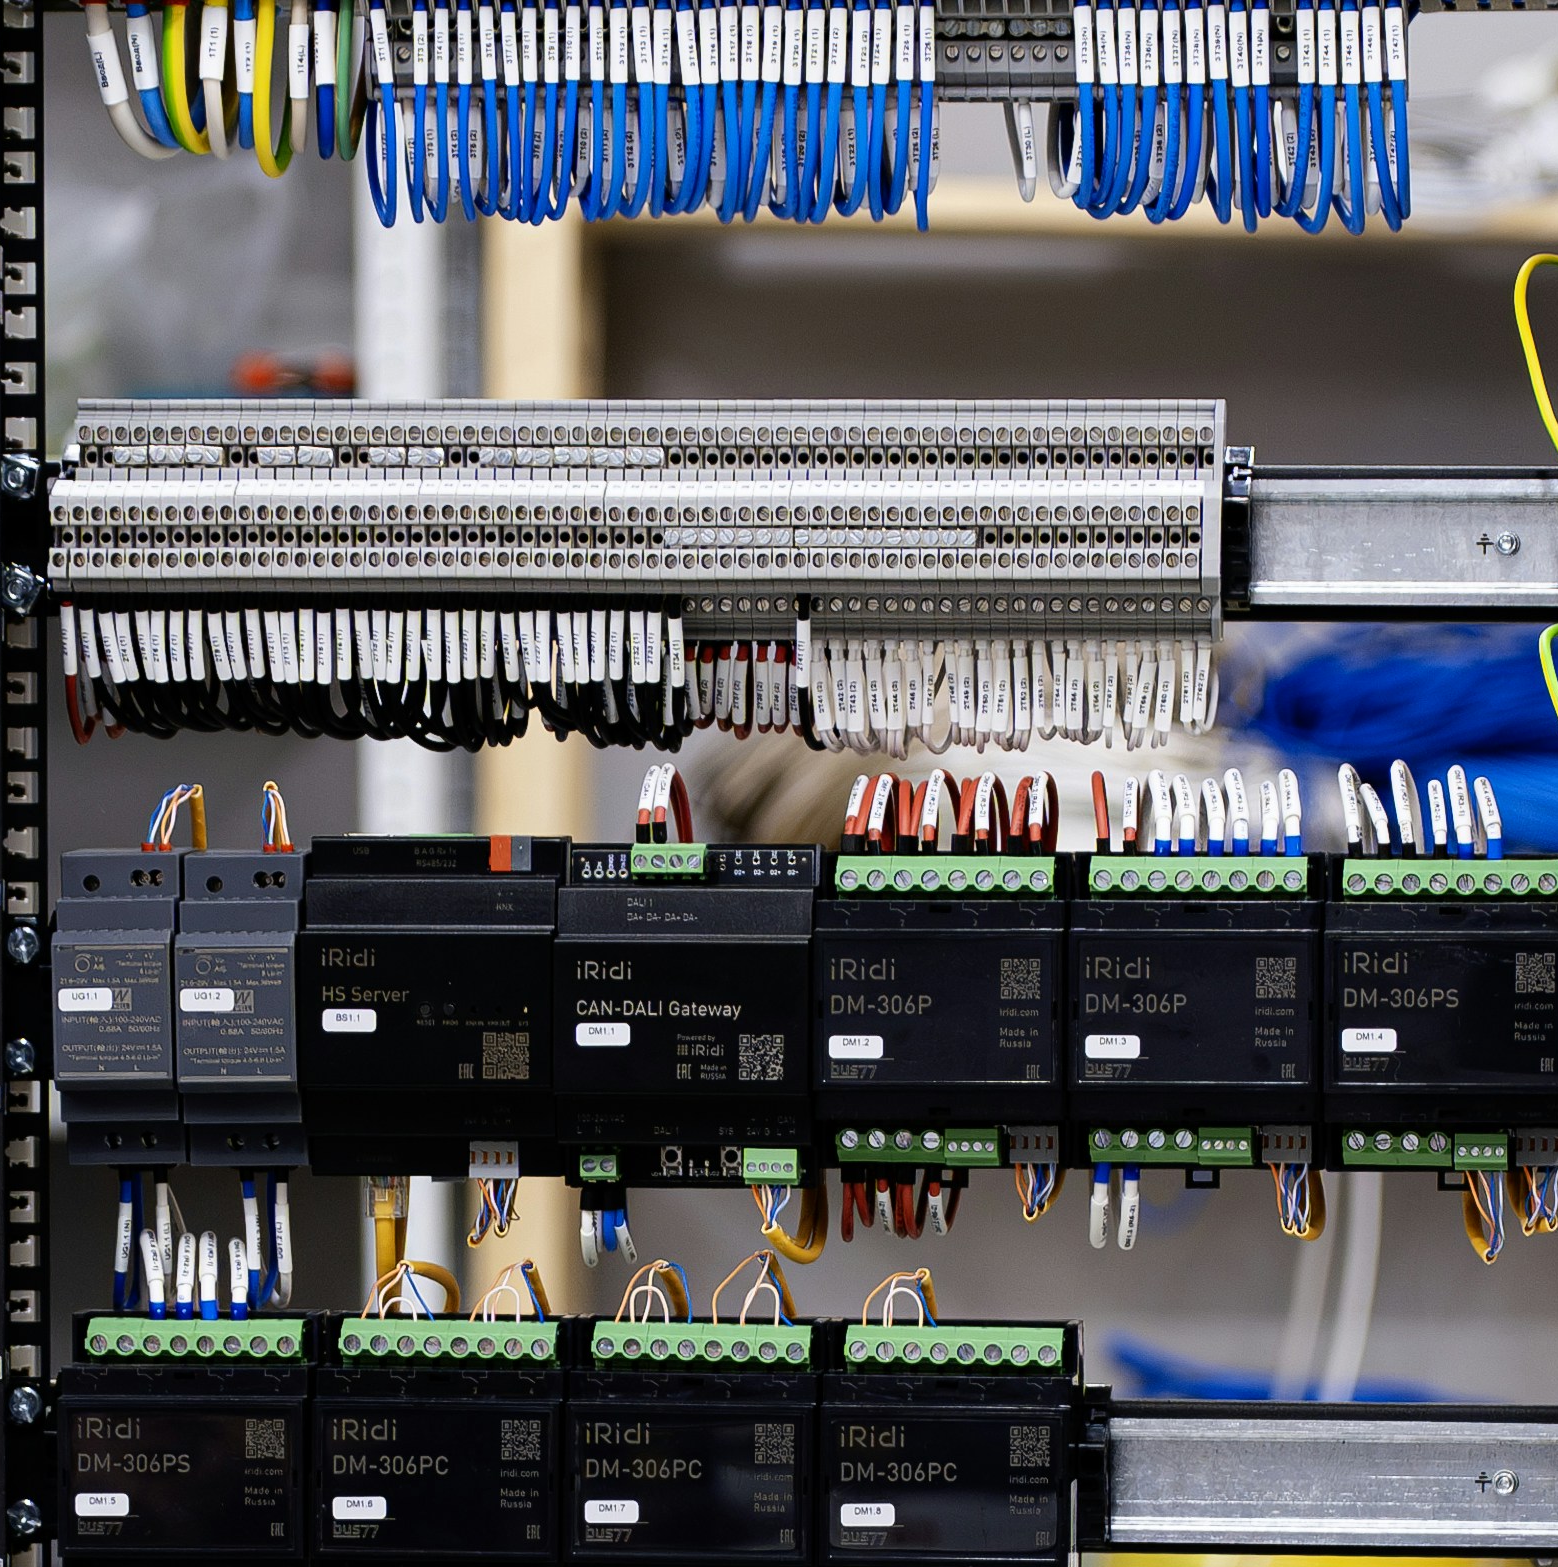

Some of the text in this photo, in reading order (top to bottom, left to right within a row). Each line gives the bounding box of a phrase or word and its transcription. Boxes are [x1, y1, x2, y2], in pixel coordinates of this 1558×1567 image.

[322, 949, 375, 966] iRidi
[1345, 952, 1407, 974] iRidi
[578, 961, 631, 979] iRidi
[831, 958, 894, 980] iRidi
[1086, 957, 1150, 979] iRidi
[323, 986, 409, 1002] HS Server
[1086, 994, 1186, 1013] DM-306P
[1344, 988, 1458, 1007] DM-306PS
[577, 1000, 741, 1020] CAN-DALI Gateway
[831, 995, 931, 1014] DM-306P
[78, 1418, 139, 1439] iRidi
[333, 1419, 396, 1440] iRidi
[586, 1423, 649, 1444] iRidi
[841, 1426, 904, 1447] iRidi
[78, 1453, 190, 1472] DM-306PS
[334, 1455, 448, 1475] DM-306PC
[586, 1459, 701, 1478] DM-306PC
[841, 1462, 957, 1481] DM-306PC
